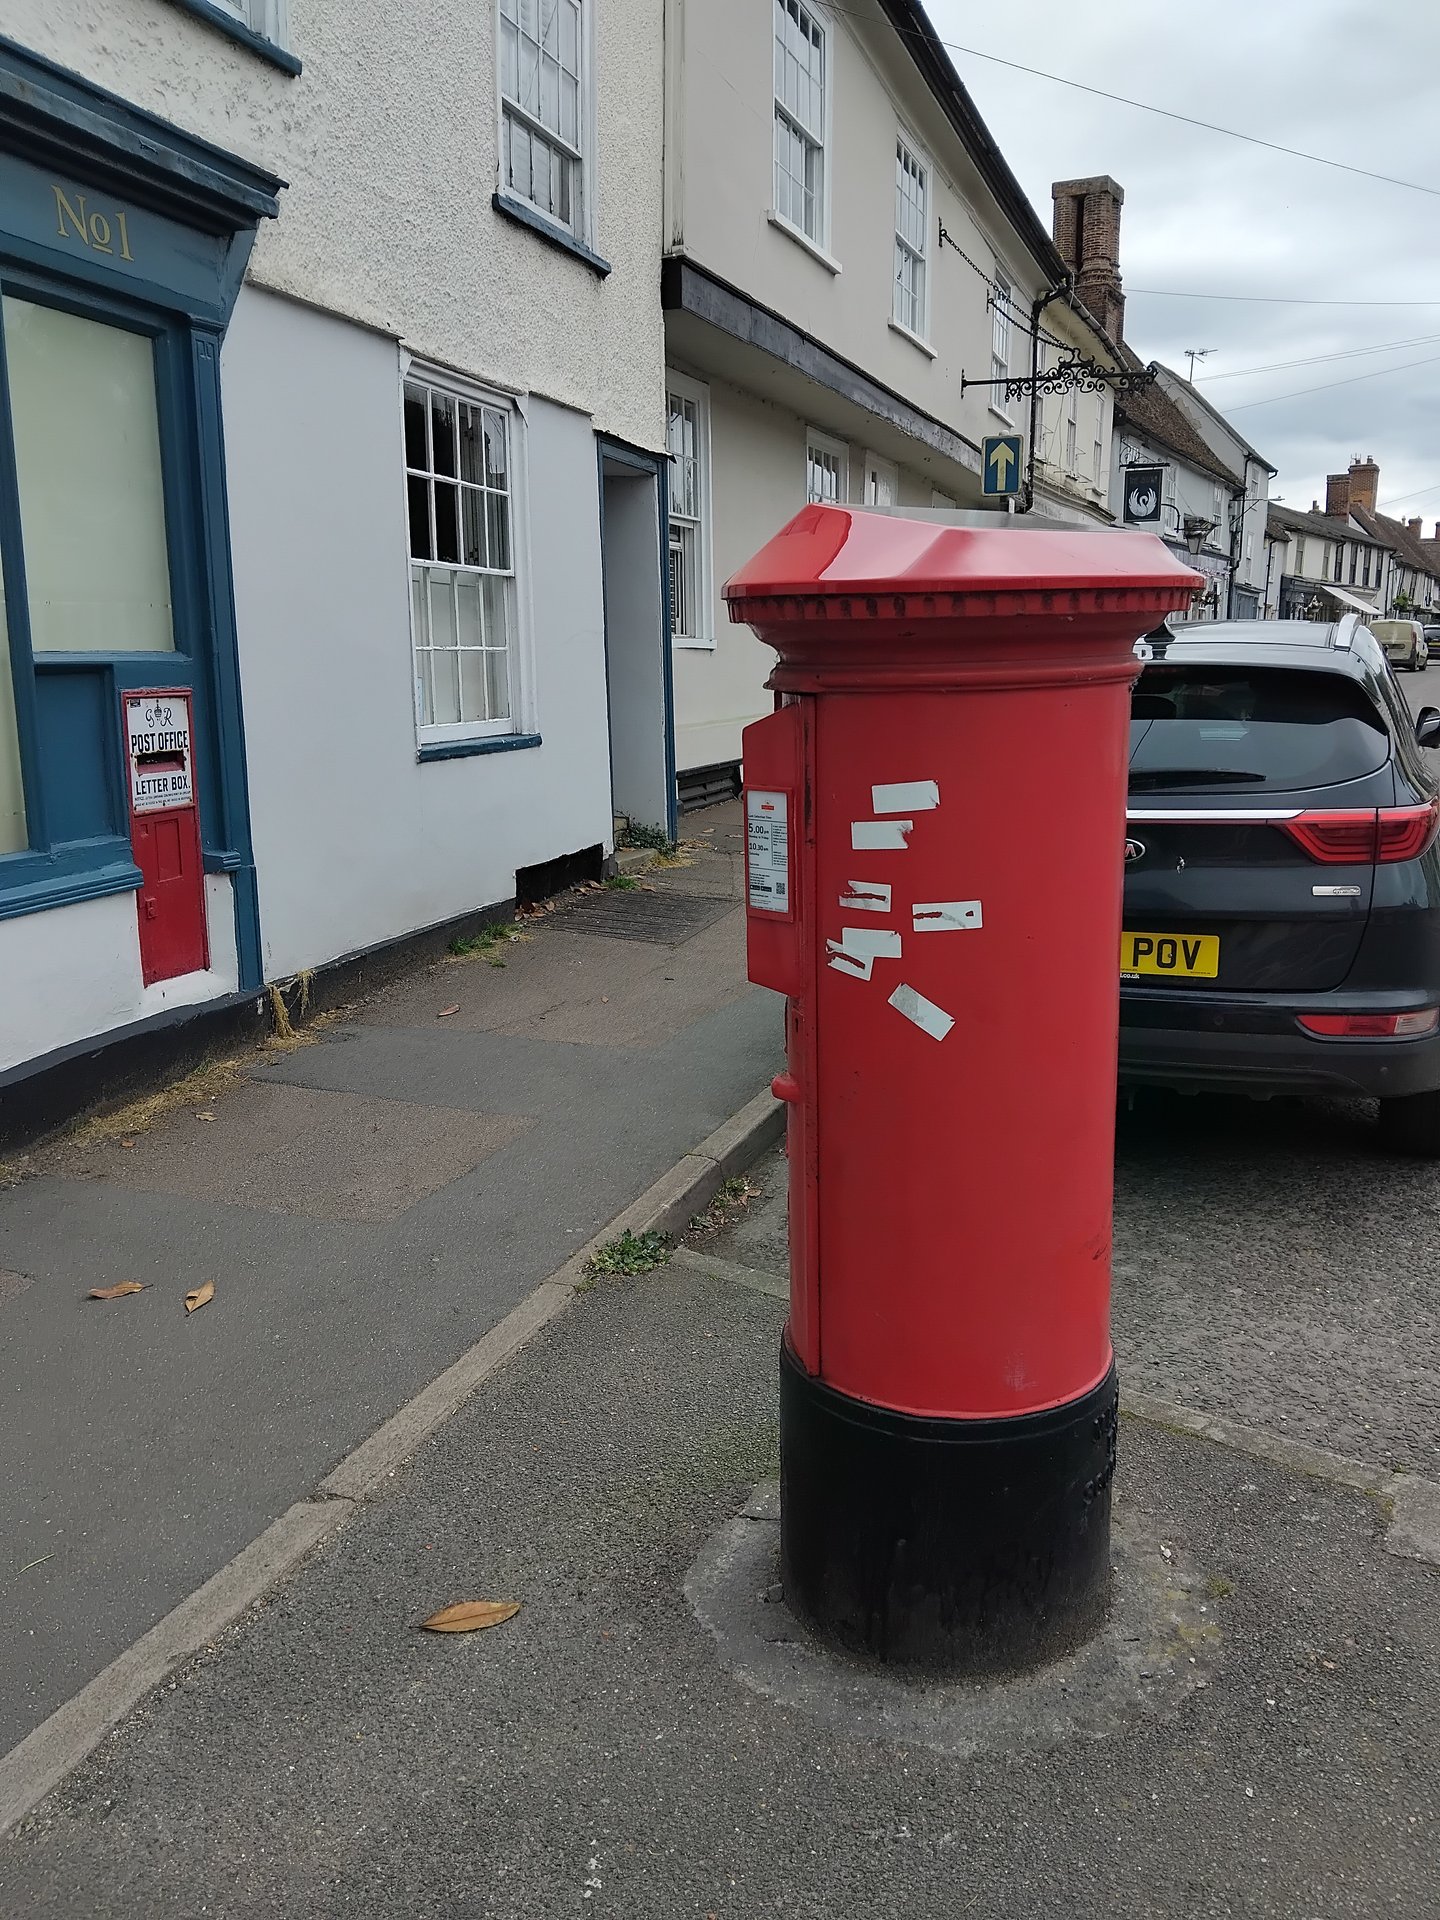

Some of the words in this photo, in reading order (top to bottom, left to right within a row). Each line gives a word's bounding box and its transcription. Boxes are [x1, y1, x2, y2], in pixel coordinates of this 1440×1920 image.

[131, 733, 156, 753] POST
[158, 730, 189, 751] OFFICE
[135, 777, 169, 796] LETTER
[171, 775, 191, 791] BOX.
[1132, 937, 1202, 970] POV
